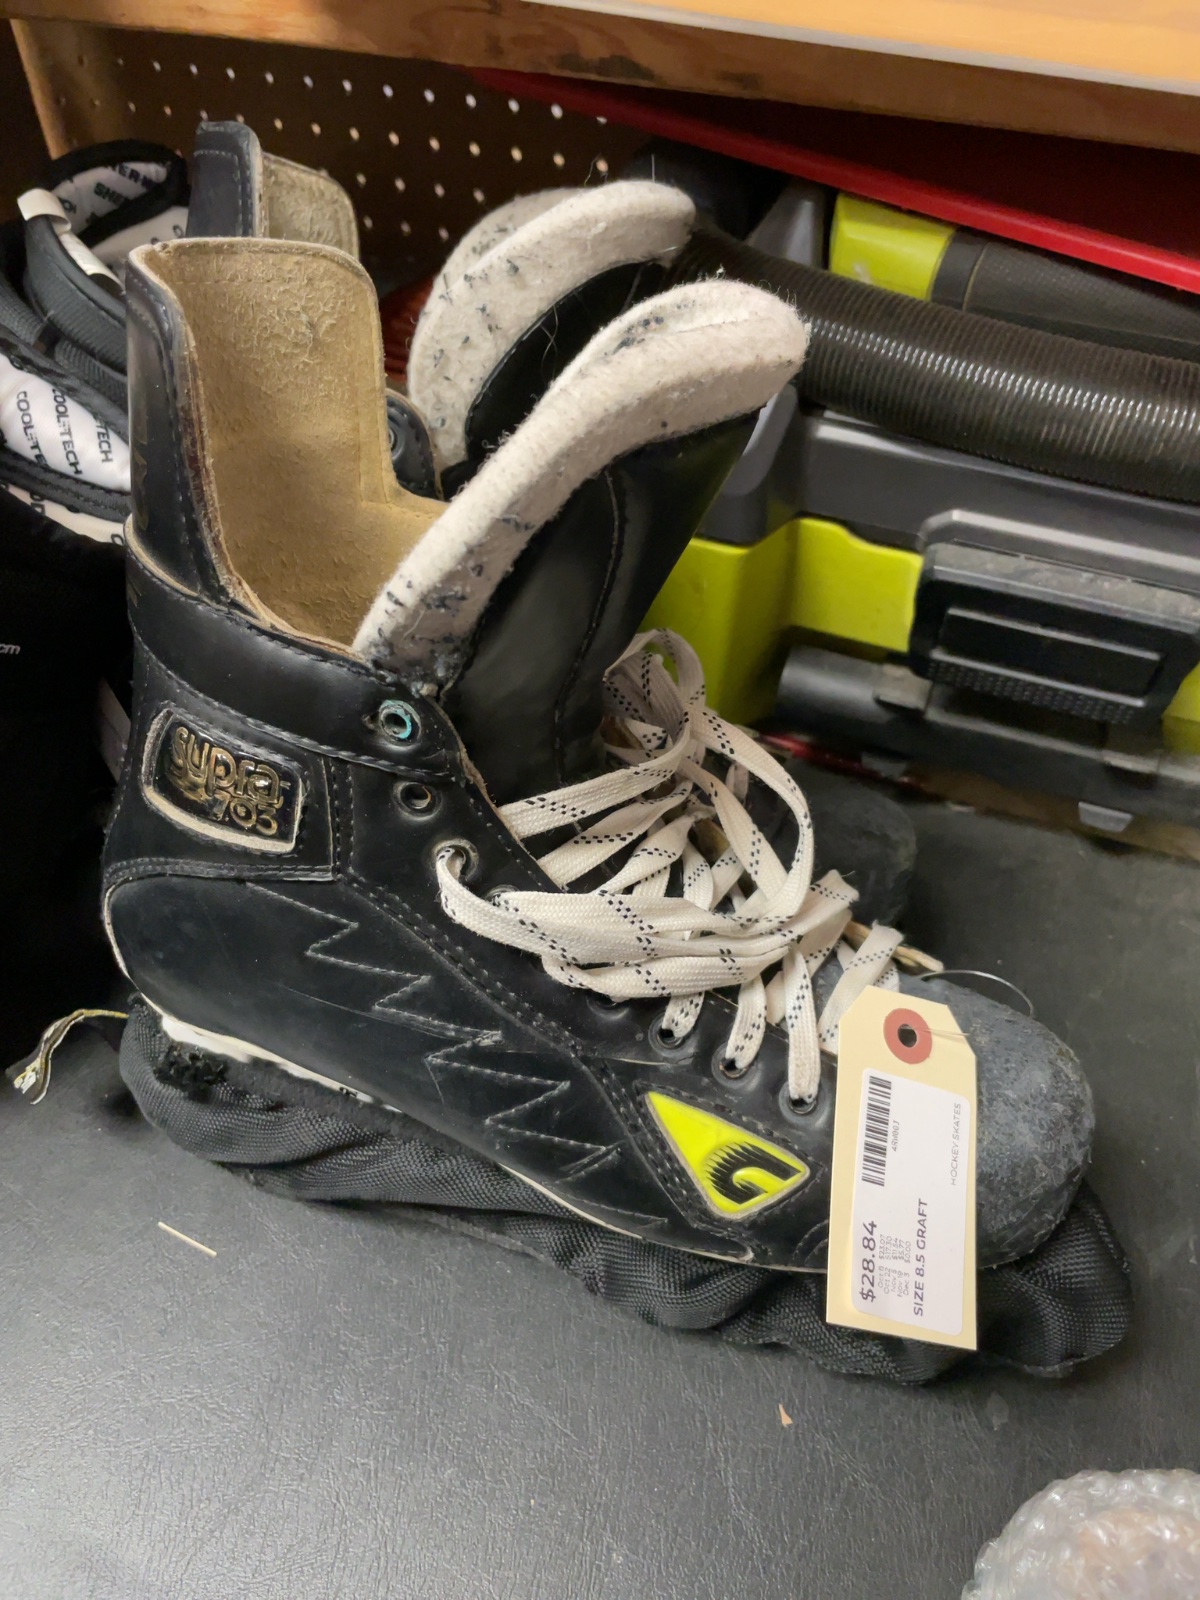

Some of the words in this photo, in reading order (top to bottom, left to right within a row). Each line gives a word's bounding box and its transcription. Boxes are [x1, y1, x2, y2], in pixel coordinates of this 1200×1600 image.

[952, 1103, 961, 1140] SKATES
[950, 1141, 959, 1186] HOCKEY
[917, 1198, 928, 1250] GRAFT
[859, 1220, 877, 1302] $28.84
[915, 1254, 925, 1277] 8.5
[914, 1281, 924, 1316] SIZE
